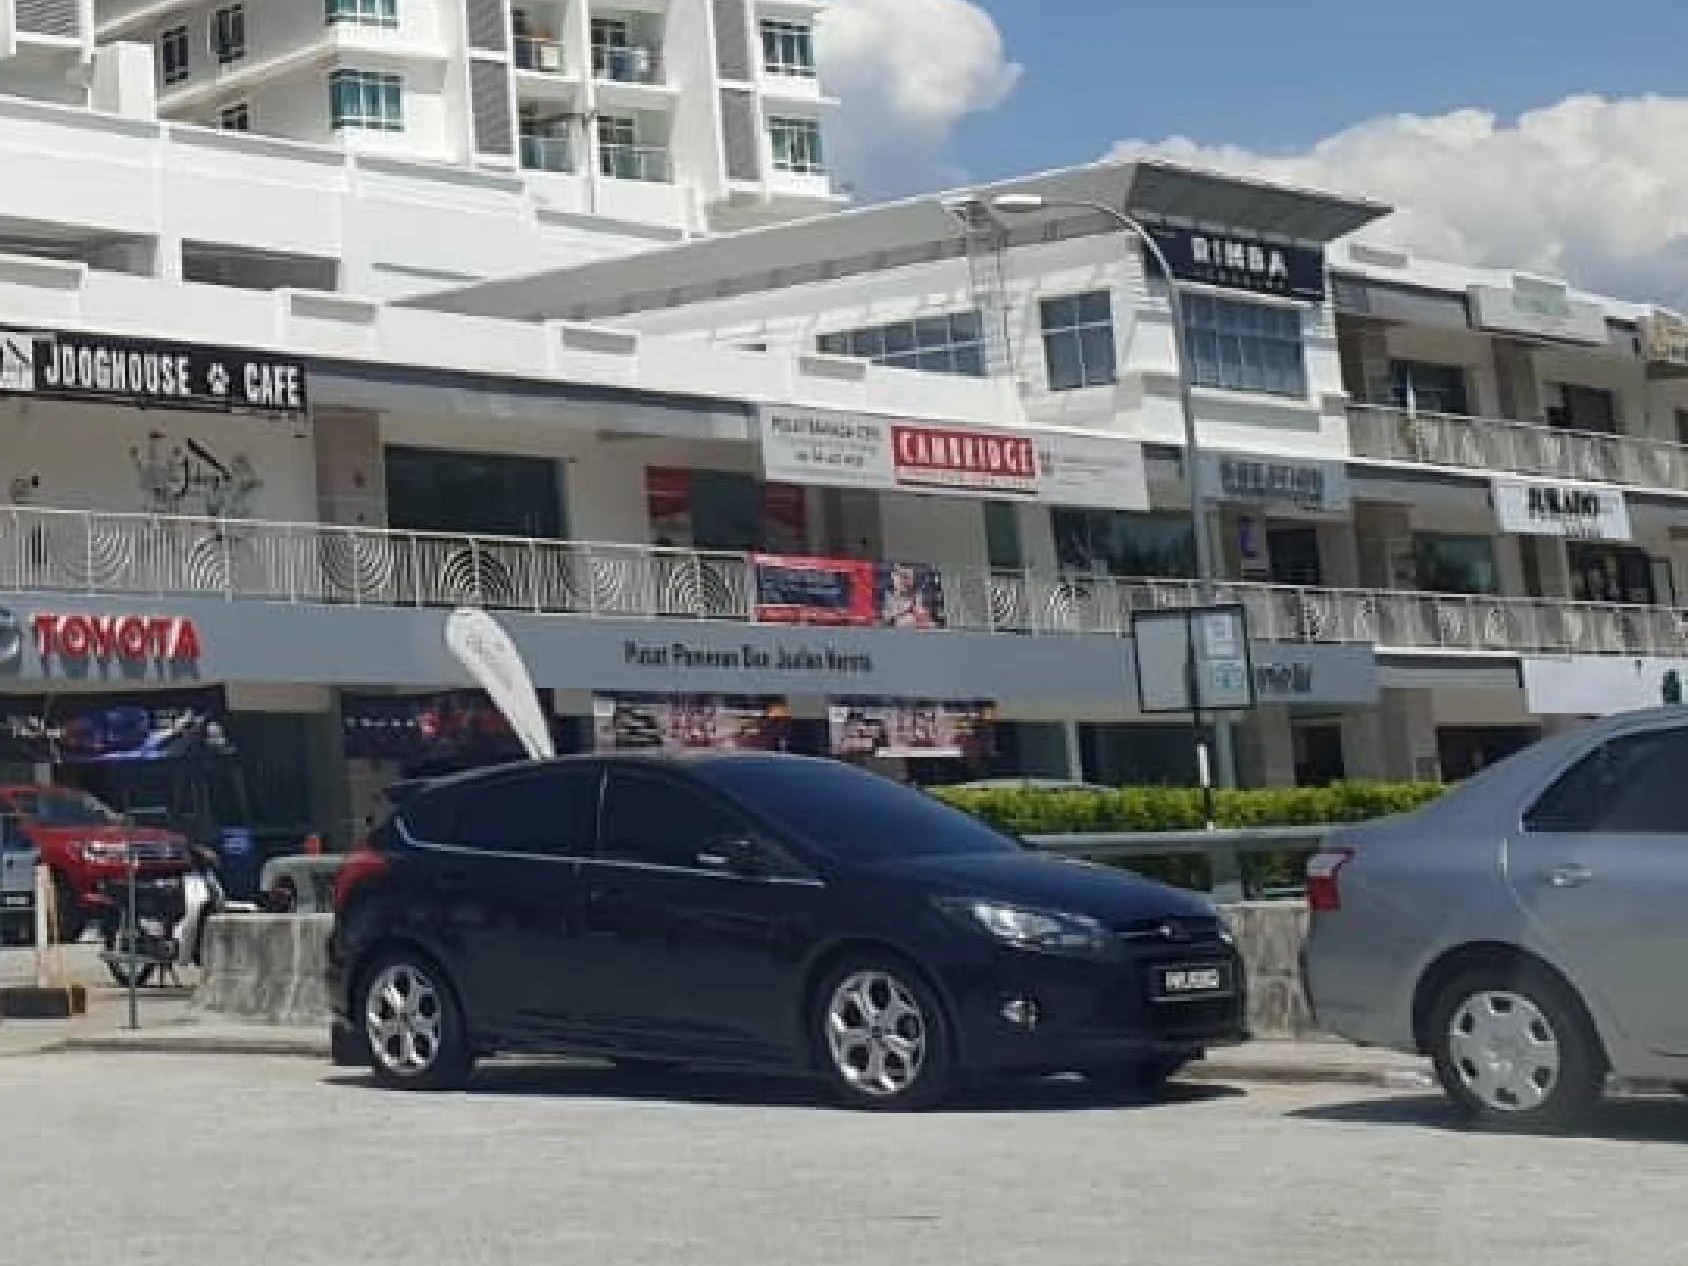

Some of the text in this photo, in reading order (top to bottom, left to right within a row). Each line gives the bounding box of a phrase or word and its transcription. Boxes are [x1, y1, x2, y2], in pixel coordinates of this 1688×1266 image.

[243, 363, 303, 408] CAFE
[898, 431, 1032, 474] CAMBRIDGE
[31, 614, 201, 660] TOYOTA
